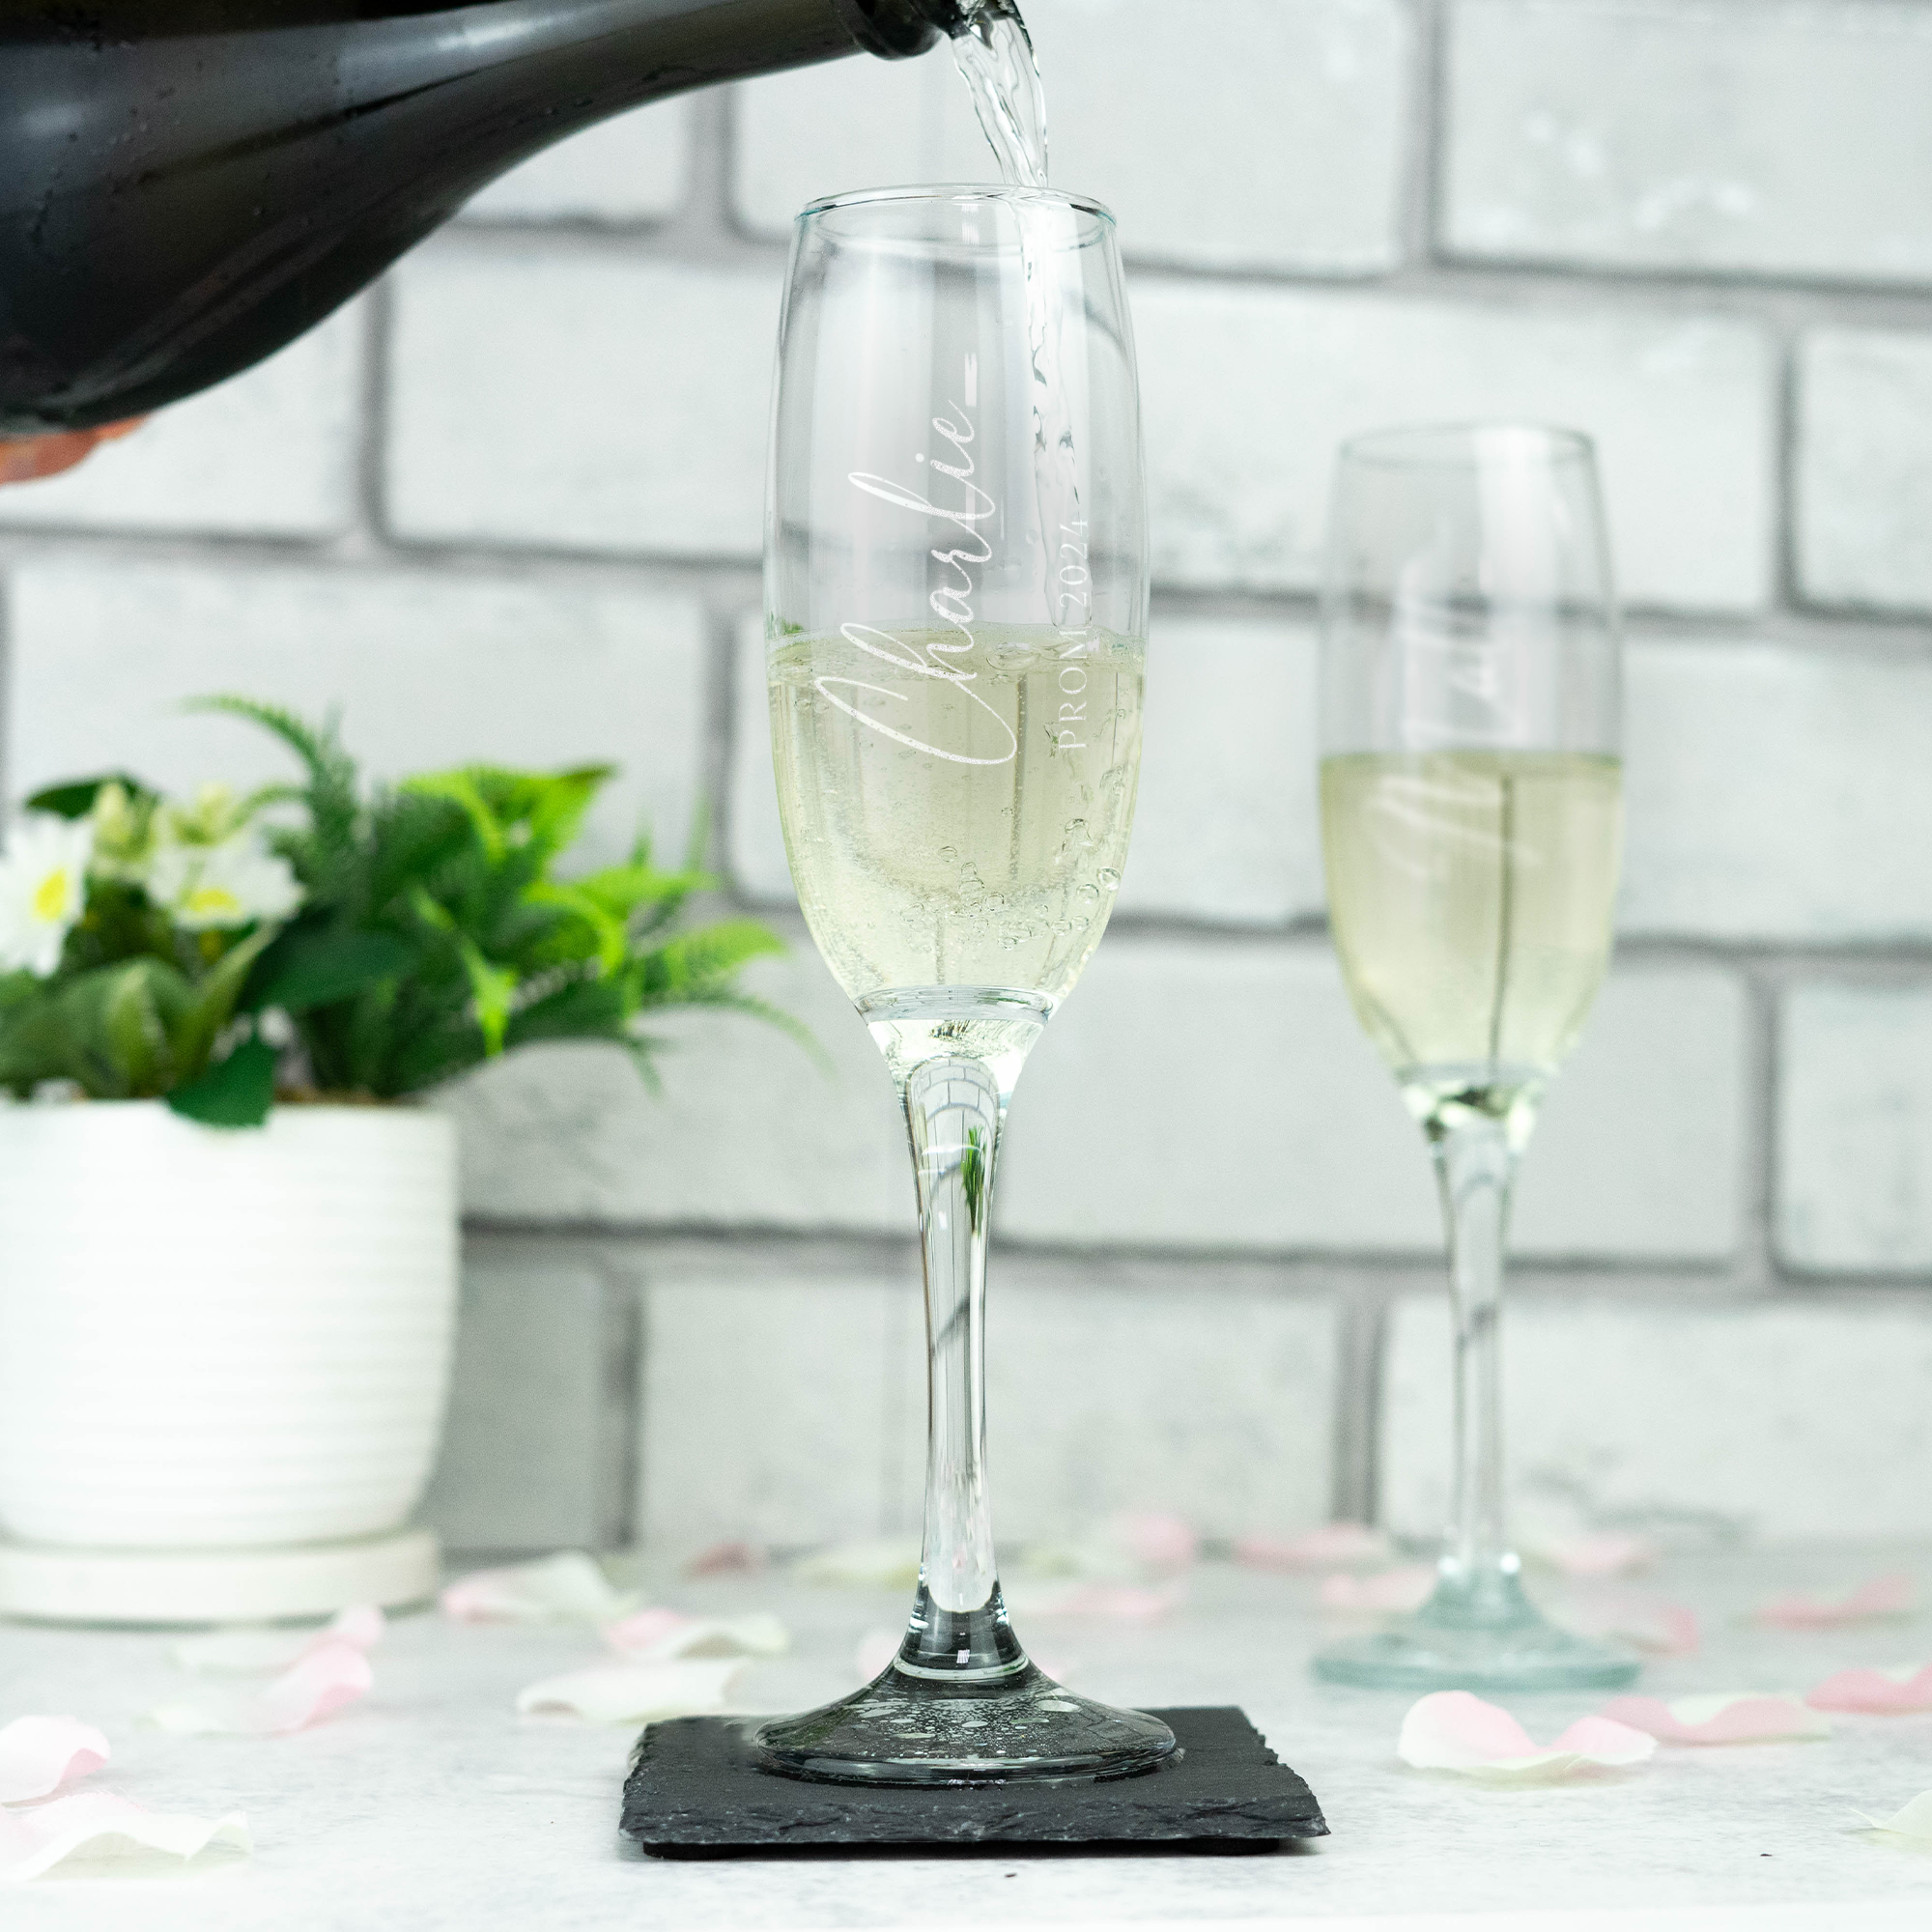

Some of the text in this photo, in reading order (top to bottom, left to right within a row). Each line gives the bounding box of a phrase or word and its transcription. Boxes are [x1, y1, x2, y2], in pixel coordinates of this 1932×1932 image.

[814, 399, 1017, 765] Charlie
[1059, 519, 1088, 749] PROM 2024
